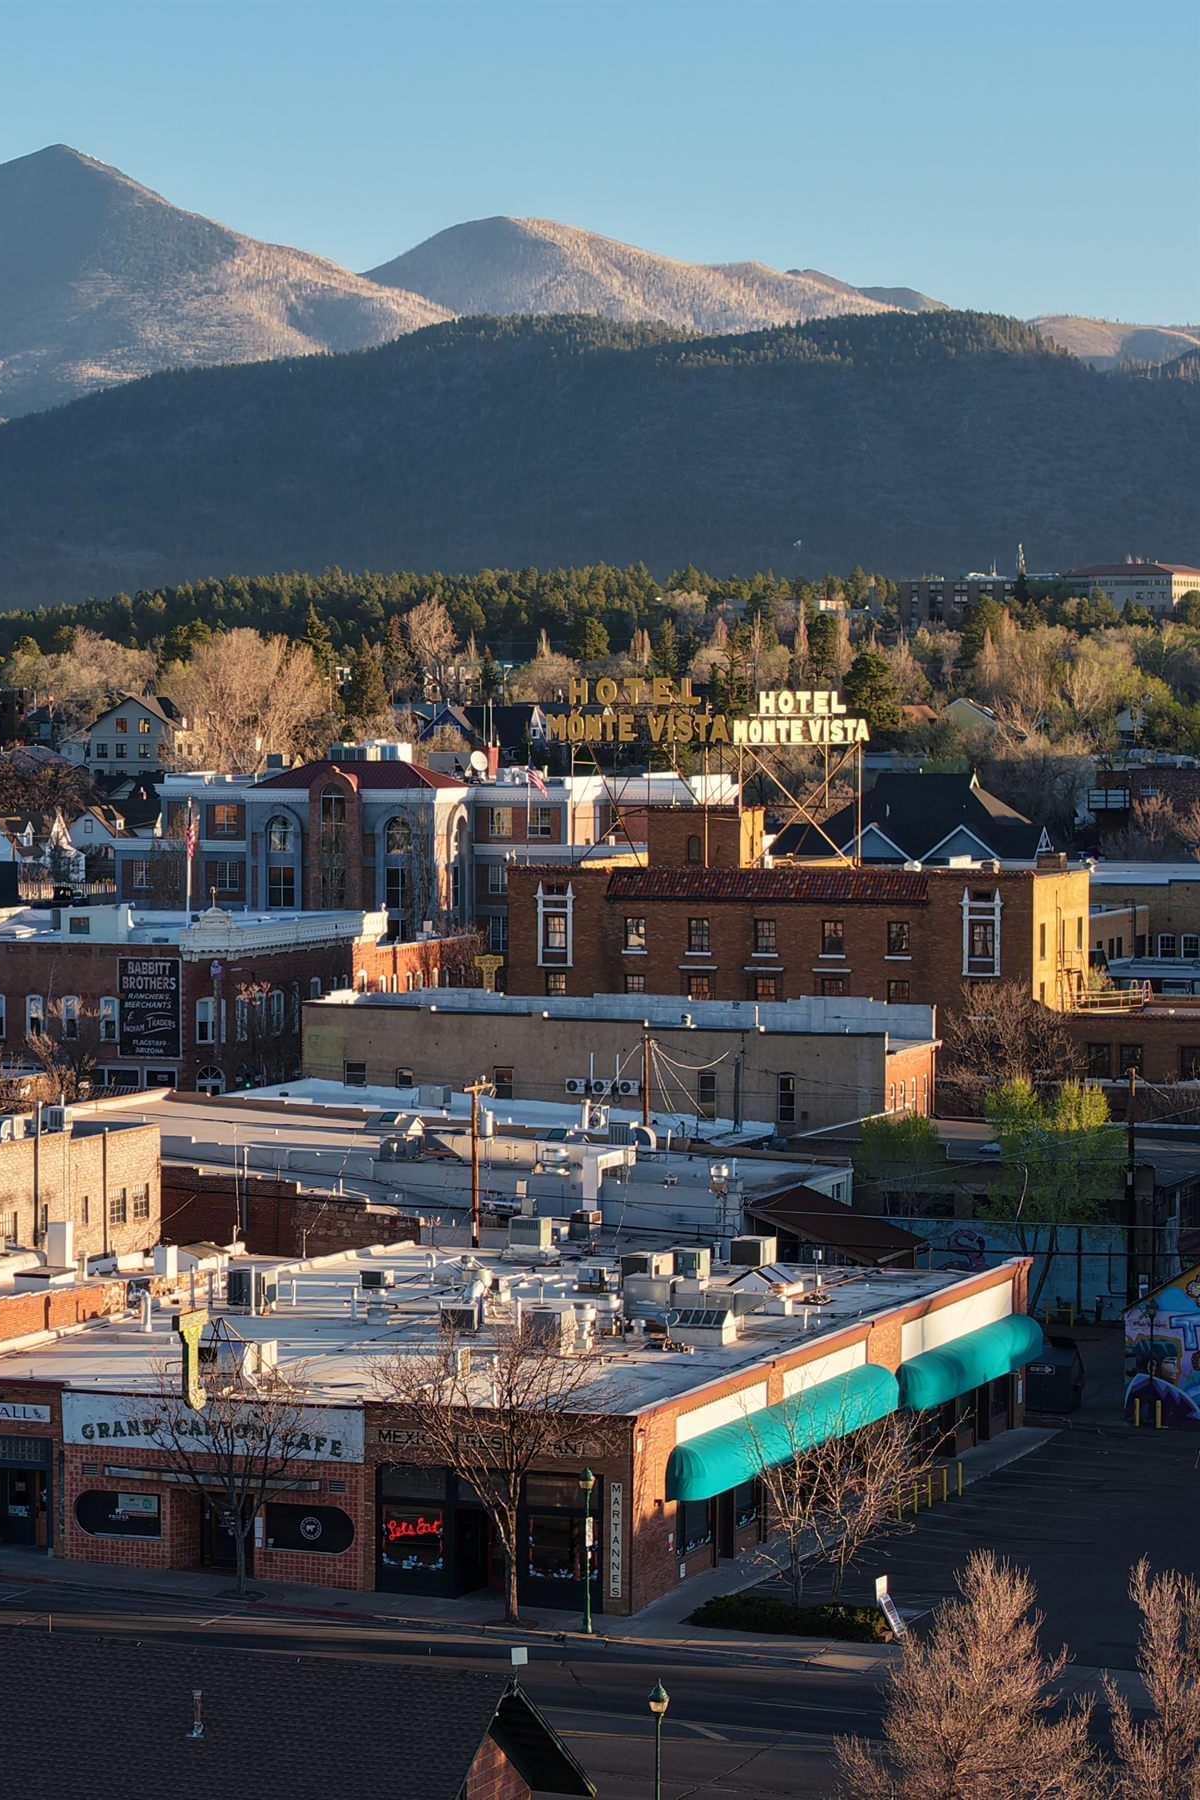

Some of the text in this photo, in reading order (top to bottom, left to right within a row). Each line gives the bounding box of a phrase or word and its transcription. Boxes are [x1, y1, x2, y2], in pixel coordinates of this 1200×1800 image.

[568, 678, 701, 704] HOTEL
[759, 690, 847, 714] HOTEL
[546, 713, 730, 742] MONTE VISTA
[733, 718, 870, 743] MONTE VISTA
[127, 961, 171, 975] BABBITT
[122, 975, 176, 990] BROTHERS
[124, 1001, 172, 1009] MERCHANTS
[81, 1419, 157, 1439] GRAND
[612, 1484, 621, 1596] MARTANNES
